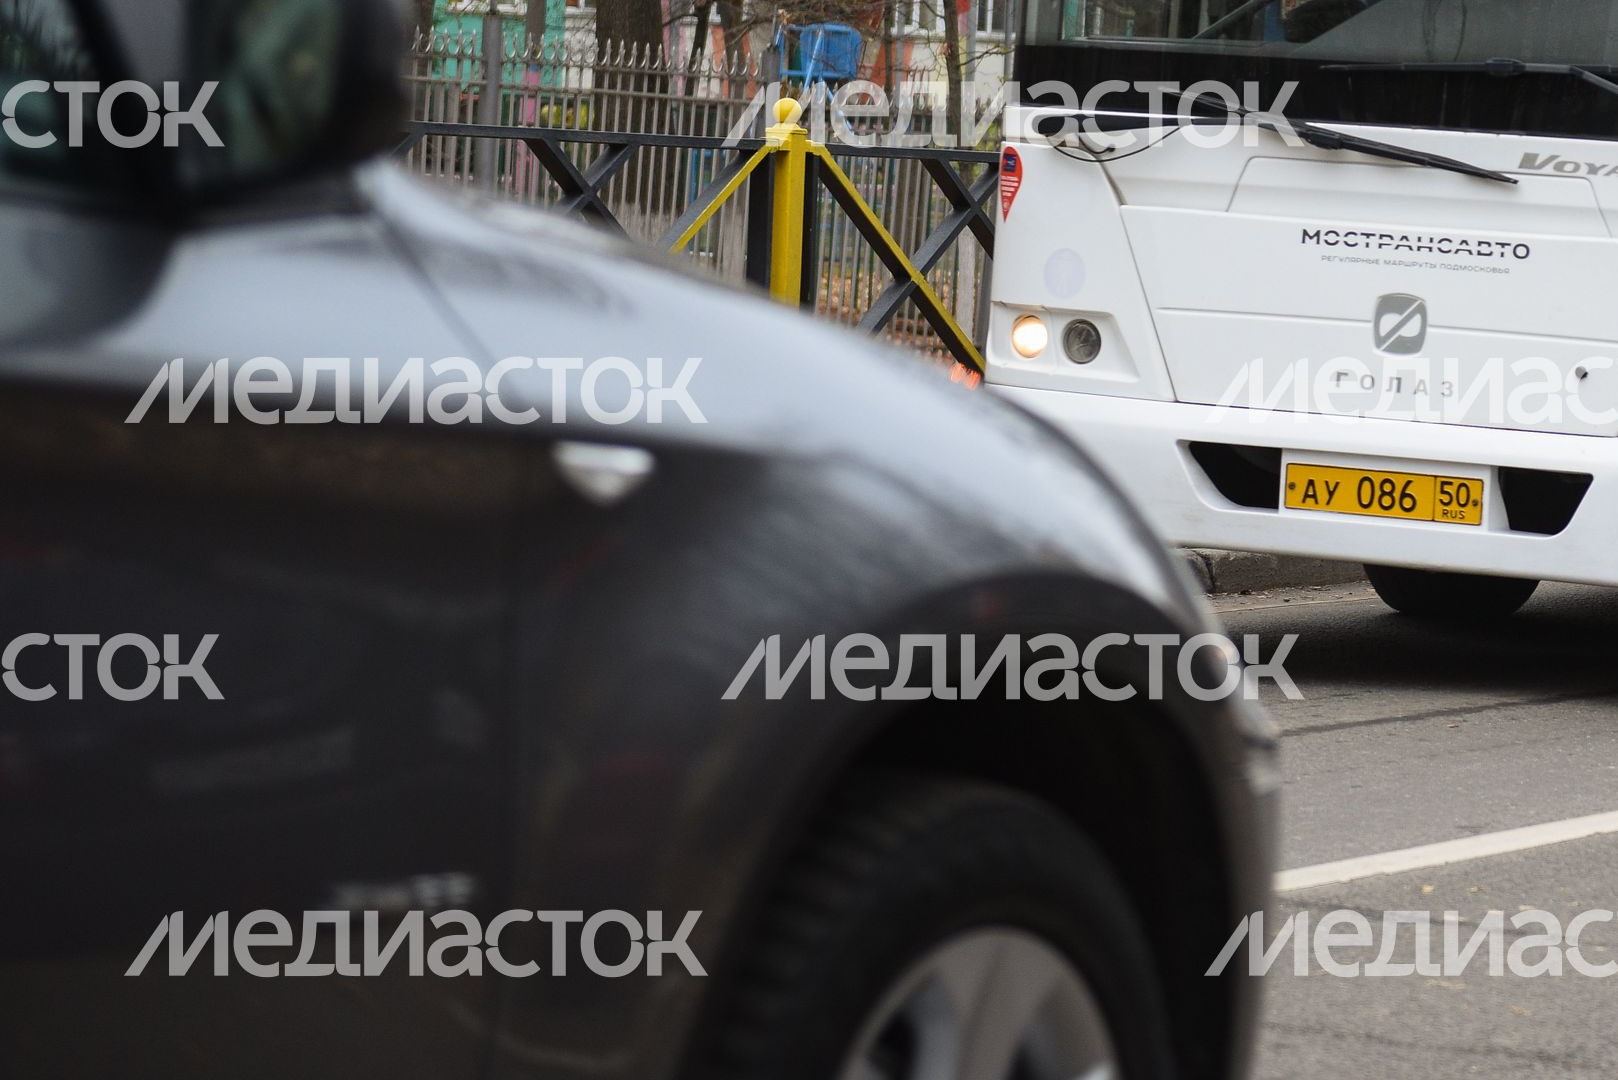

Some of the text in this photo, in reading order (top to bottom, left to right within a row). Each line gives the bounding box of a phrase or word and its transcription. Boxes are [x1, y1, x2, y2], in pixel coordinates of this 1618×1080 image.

[1301, 228, 1531, 260] МОСТРАНСАВТО
[1357, 476, 1417, 513] 086
[1439, 481, 1471, 508] 50
[1442, 509, 1466, 520] RUS
